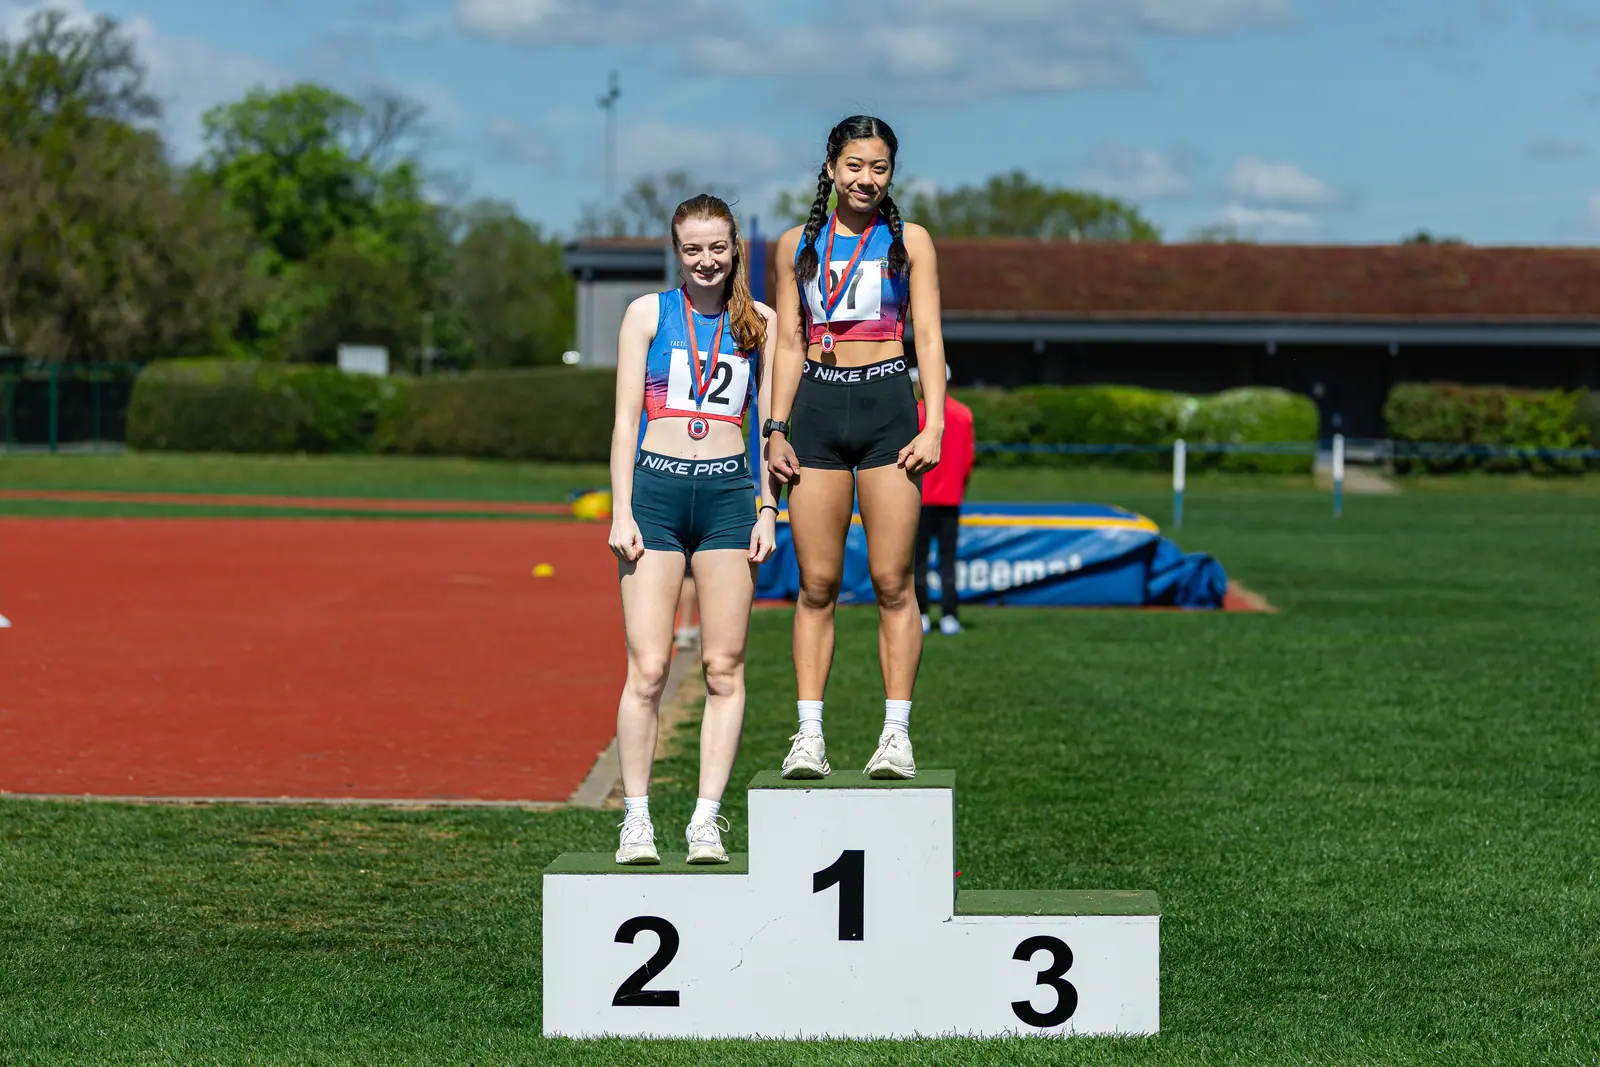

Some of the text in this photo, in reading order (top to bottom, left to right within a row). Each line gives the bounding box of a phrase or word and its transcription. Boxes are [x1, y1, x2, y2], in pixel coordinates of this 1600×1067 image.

[814, 366, 862, 382] NIKE
[866, 360, 906, 380] PRO
[642, 455, 691, 475] NIKE
[693, 460, 738, 476] PRO
[813, 850, 864, 941] 1
[612, 916, 679, 1006] 2
[1011, 936, 1078, 1028] 3
